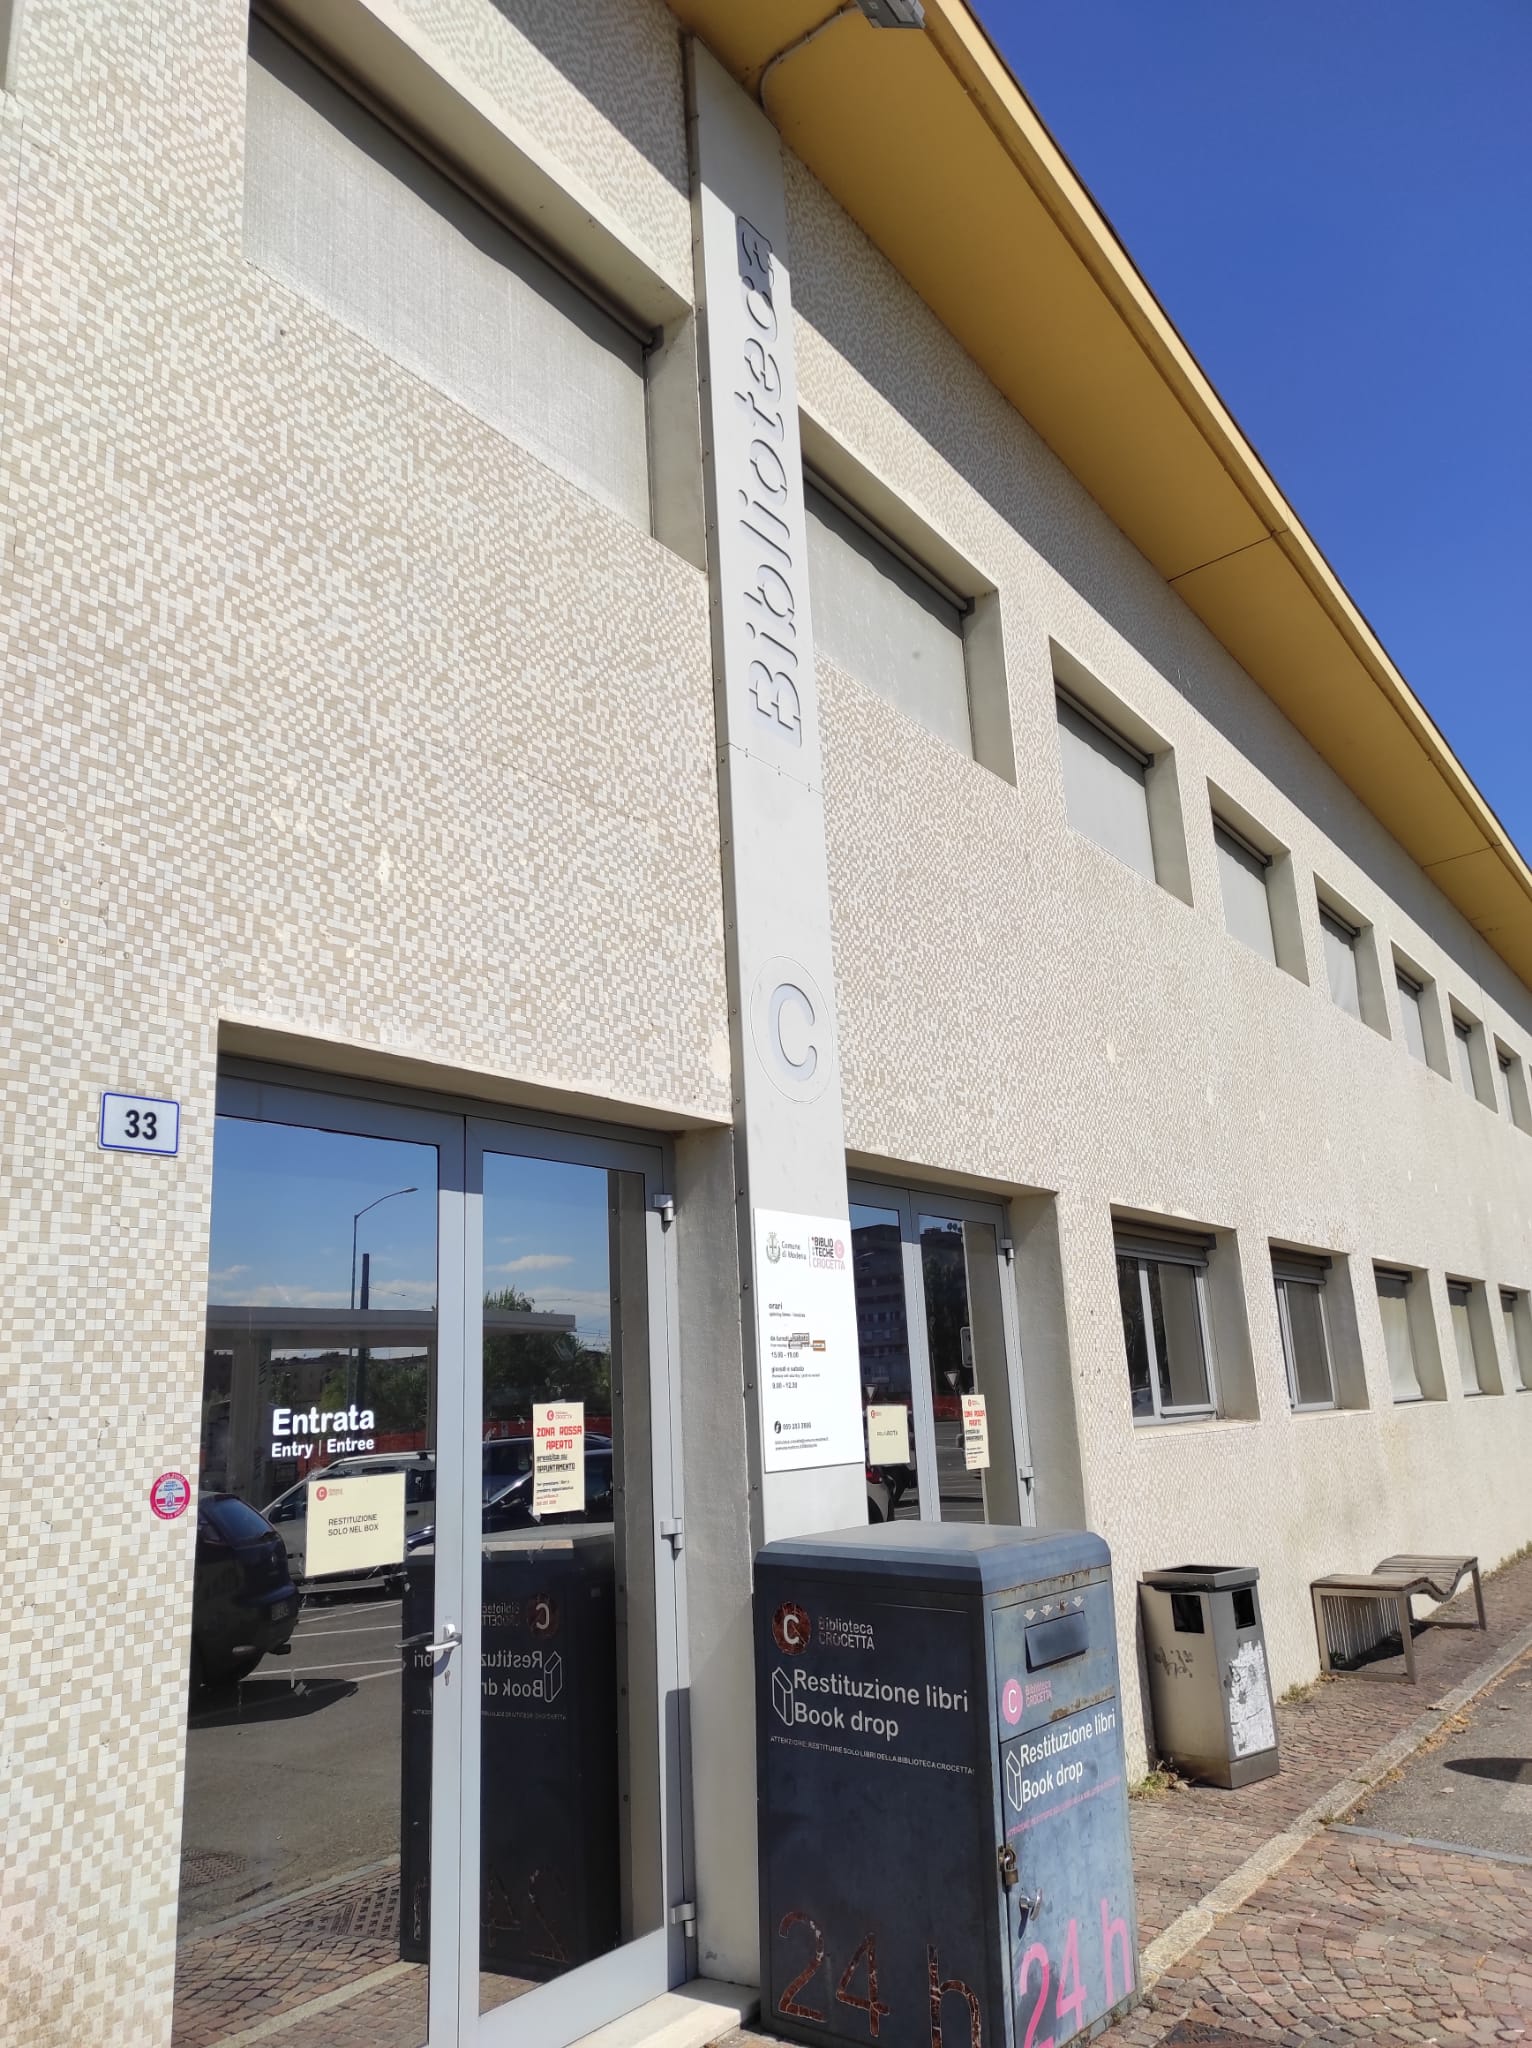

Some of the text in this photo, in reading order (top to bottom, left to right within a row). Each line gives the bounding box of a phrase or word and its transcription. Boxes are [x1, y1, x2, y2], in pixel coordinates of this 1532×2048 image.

[735, 215, 803, 748] Biblioteca
[768, 983, 817, 1082] C
[124, 1110, 157, 1140] 33
[812, 1258, 846, 1271] CROCETTA
[768, 1302, 783, 1310] orari
[272, 1404, 375, 1436] Entrata
[536, 1425, 582, 1437] ZONA ROSSA
[271, 1437, 375, 1459] Entry Entree
[546, 1440, 573, 1450] APERTO
[328, 1514, 378, 1526] RESTITUZIONE
[328, 1523, 379, 1536] SOLO NEL BOX
[783, 1614, 800, 1645] C
[818, 1616, 874, 1635] Biblioteca
[818, 1632, 876, 1650] CROCETTA
[793, 1668, 969, 1713] Restituzione libri
[794, 1702, 900, 1742] Book drop
[1020, 1708, 1116, 1768] Restituzione libri
[808, 1741, 843, 1754] RESTITUIRE
[843, 1747, 860, 1756] SOLO
[860, 1750, 876, 1759] LIBRI
[876, 1753, 897, 1762] DELLA
[897, 1756, 937, 1769] BIBLIOTECA
[1022, 1770, 1054, 1803] Book
[1056, 1761, 1083, 1787] drop
[779, 1911, 981, 2048] 24 h
[1019, 1898, 1133, 2048] 24 h
